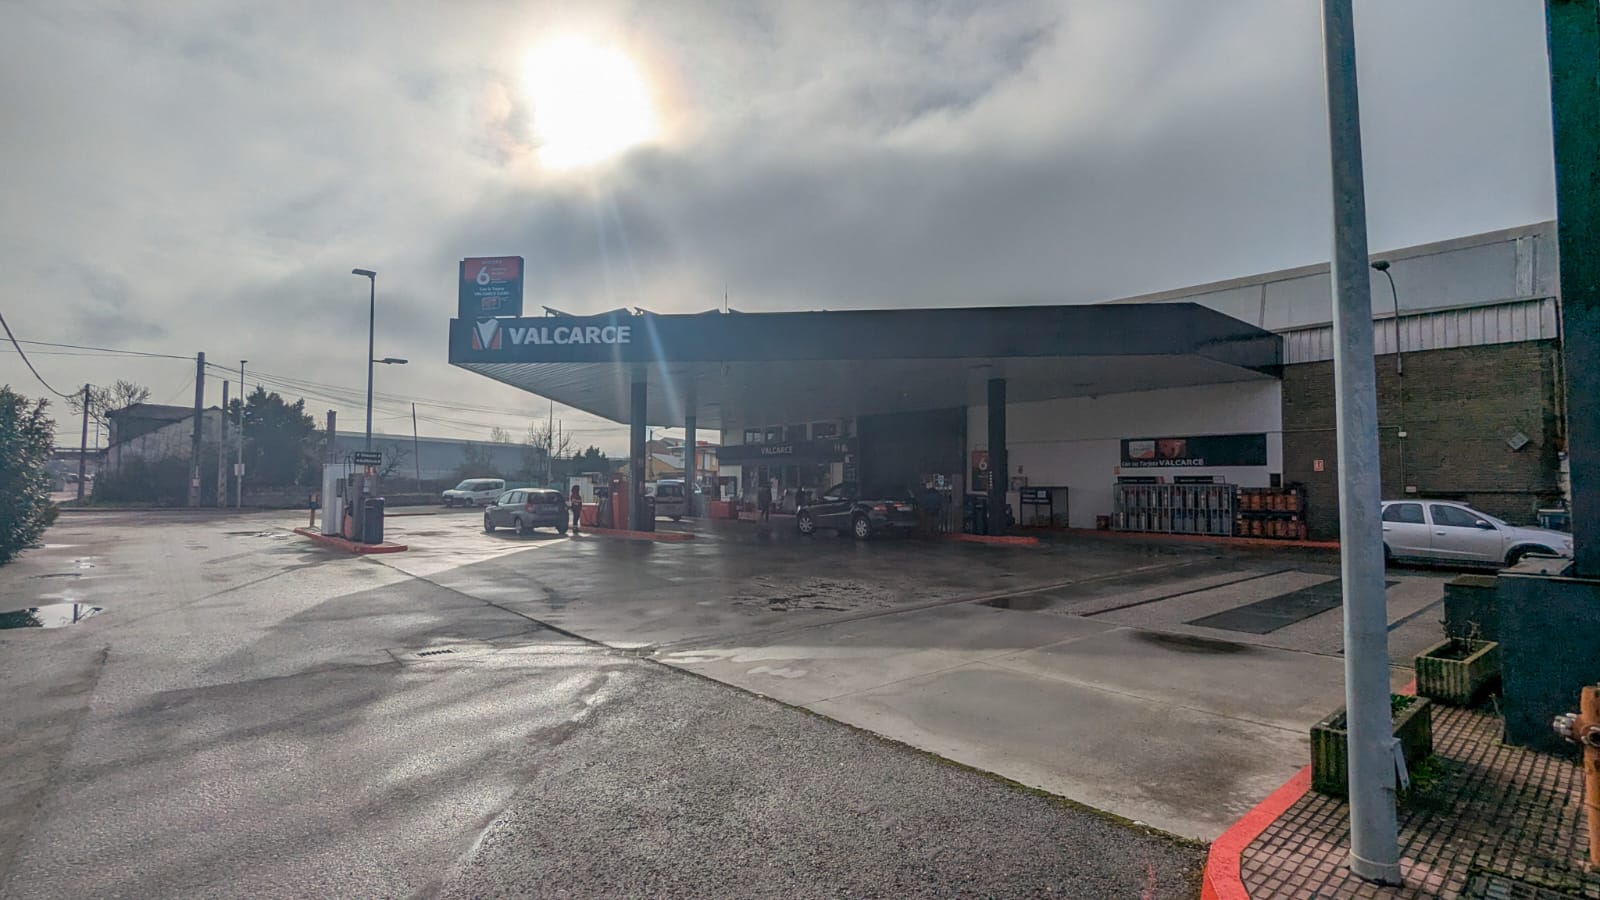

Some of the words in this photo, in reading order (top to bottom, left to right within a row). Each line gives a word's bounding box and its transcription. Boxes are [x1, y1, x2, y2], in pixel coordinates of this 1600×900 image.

[476, 265, 490, 285] 6
[508, 325, 631, 345] VALCARCE
[760, 446, 793, 455] VALCARCE
[978, 457, 988, 470] 6
[1159, 458, 1204, 467] VALCARCE
